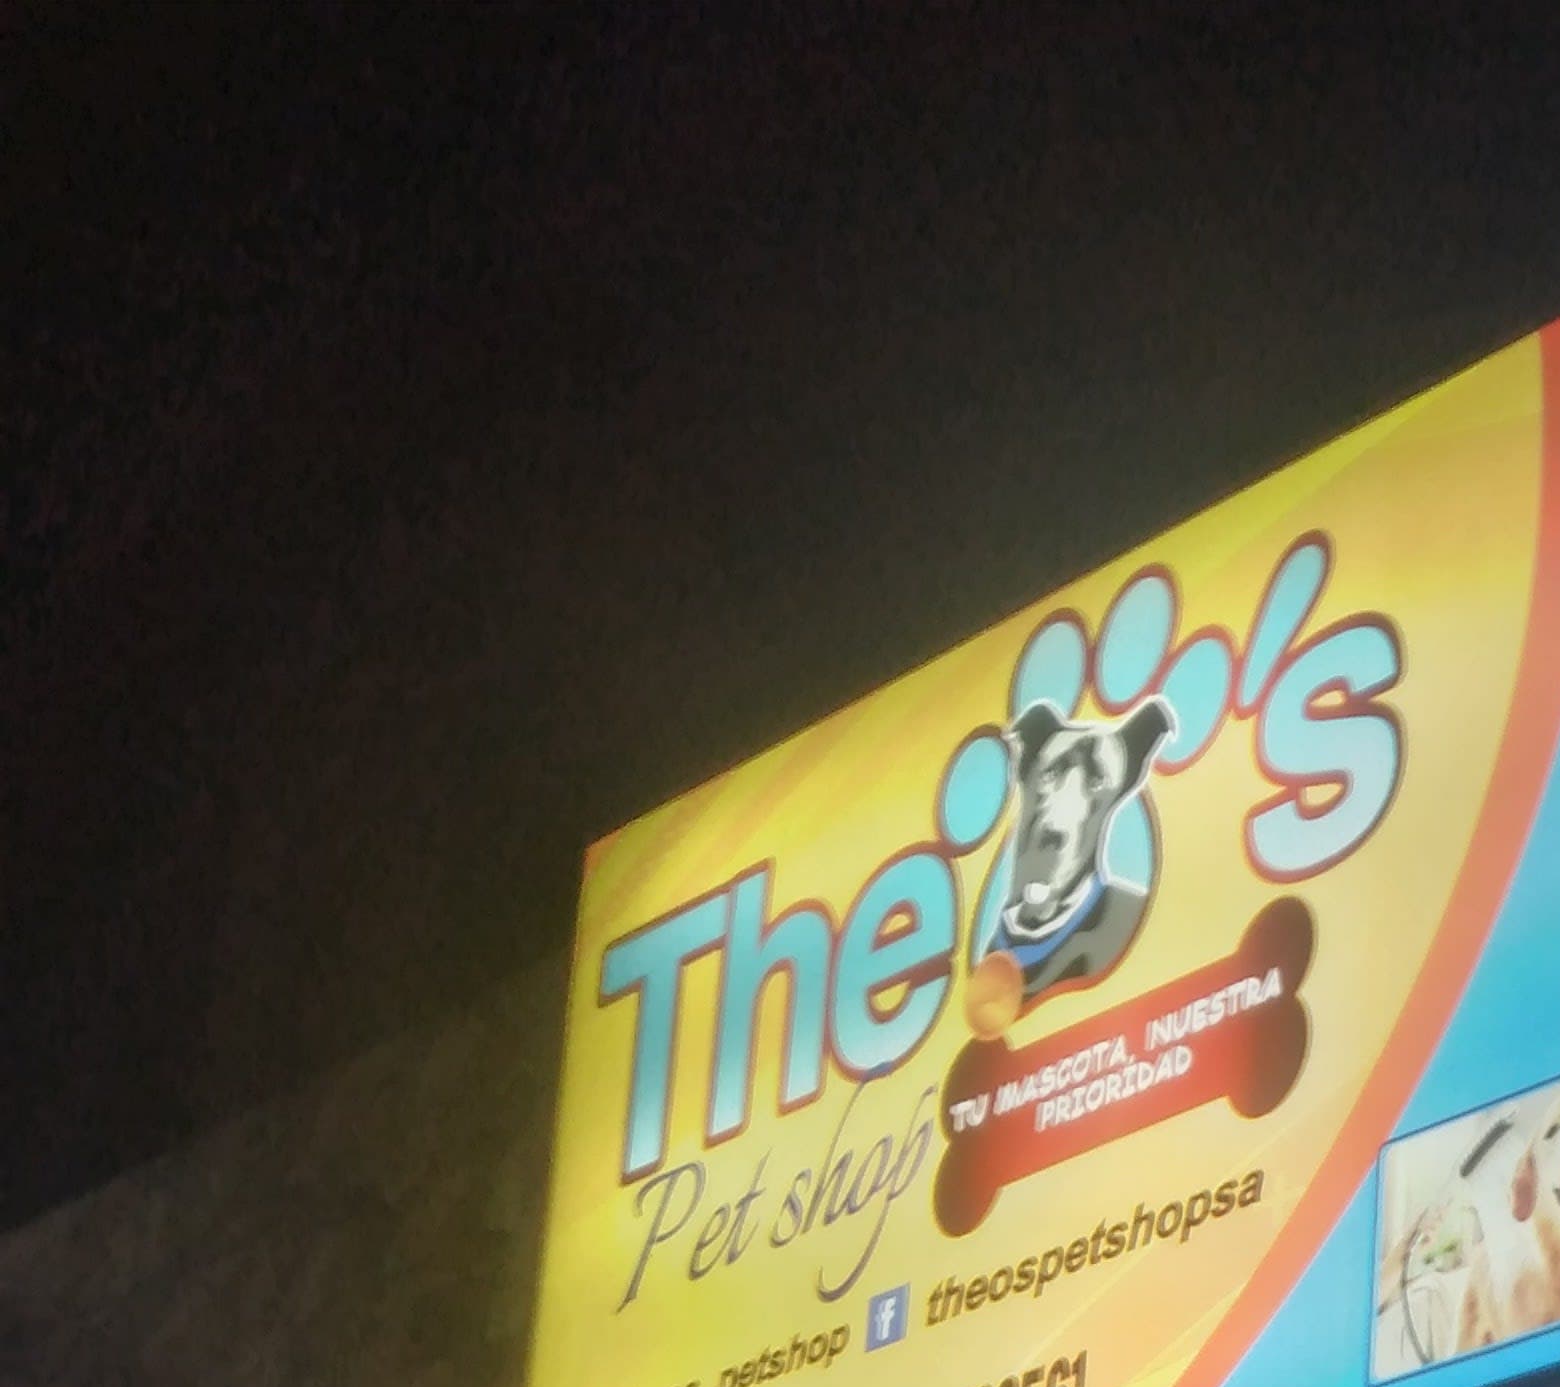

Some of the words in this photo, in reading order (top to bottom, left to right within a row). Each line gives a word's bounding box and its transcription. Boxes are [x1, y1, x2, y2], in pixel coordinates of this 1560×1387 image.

[950, 1093, 988, 1132] TU
[1145, 967, 1283, 1050] NUESTRA
[1035, 1046, 1193, 1132] PRIORIDAD
[616, 1140, 775, 1315] Pet
[768, 1065, 938, 1303] shop
[925, 1169, 1264, 1328] theospetshopsa
